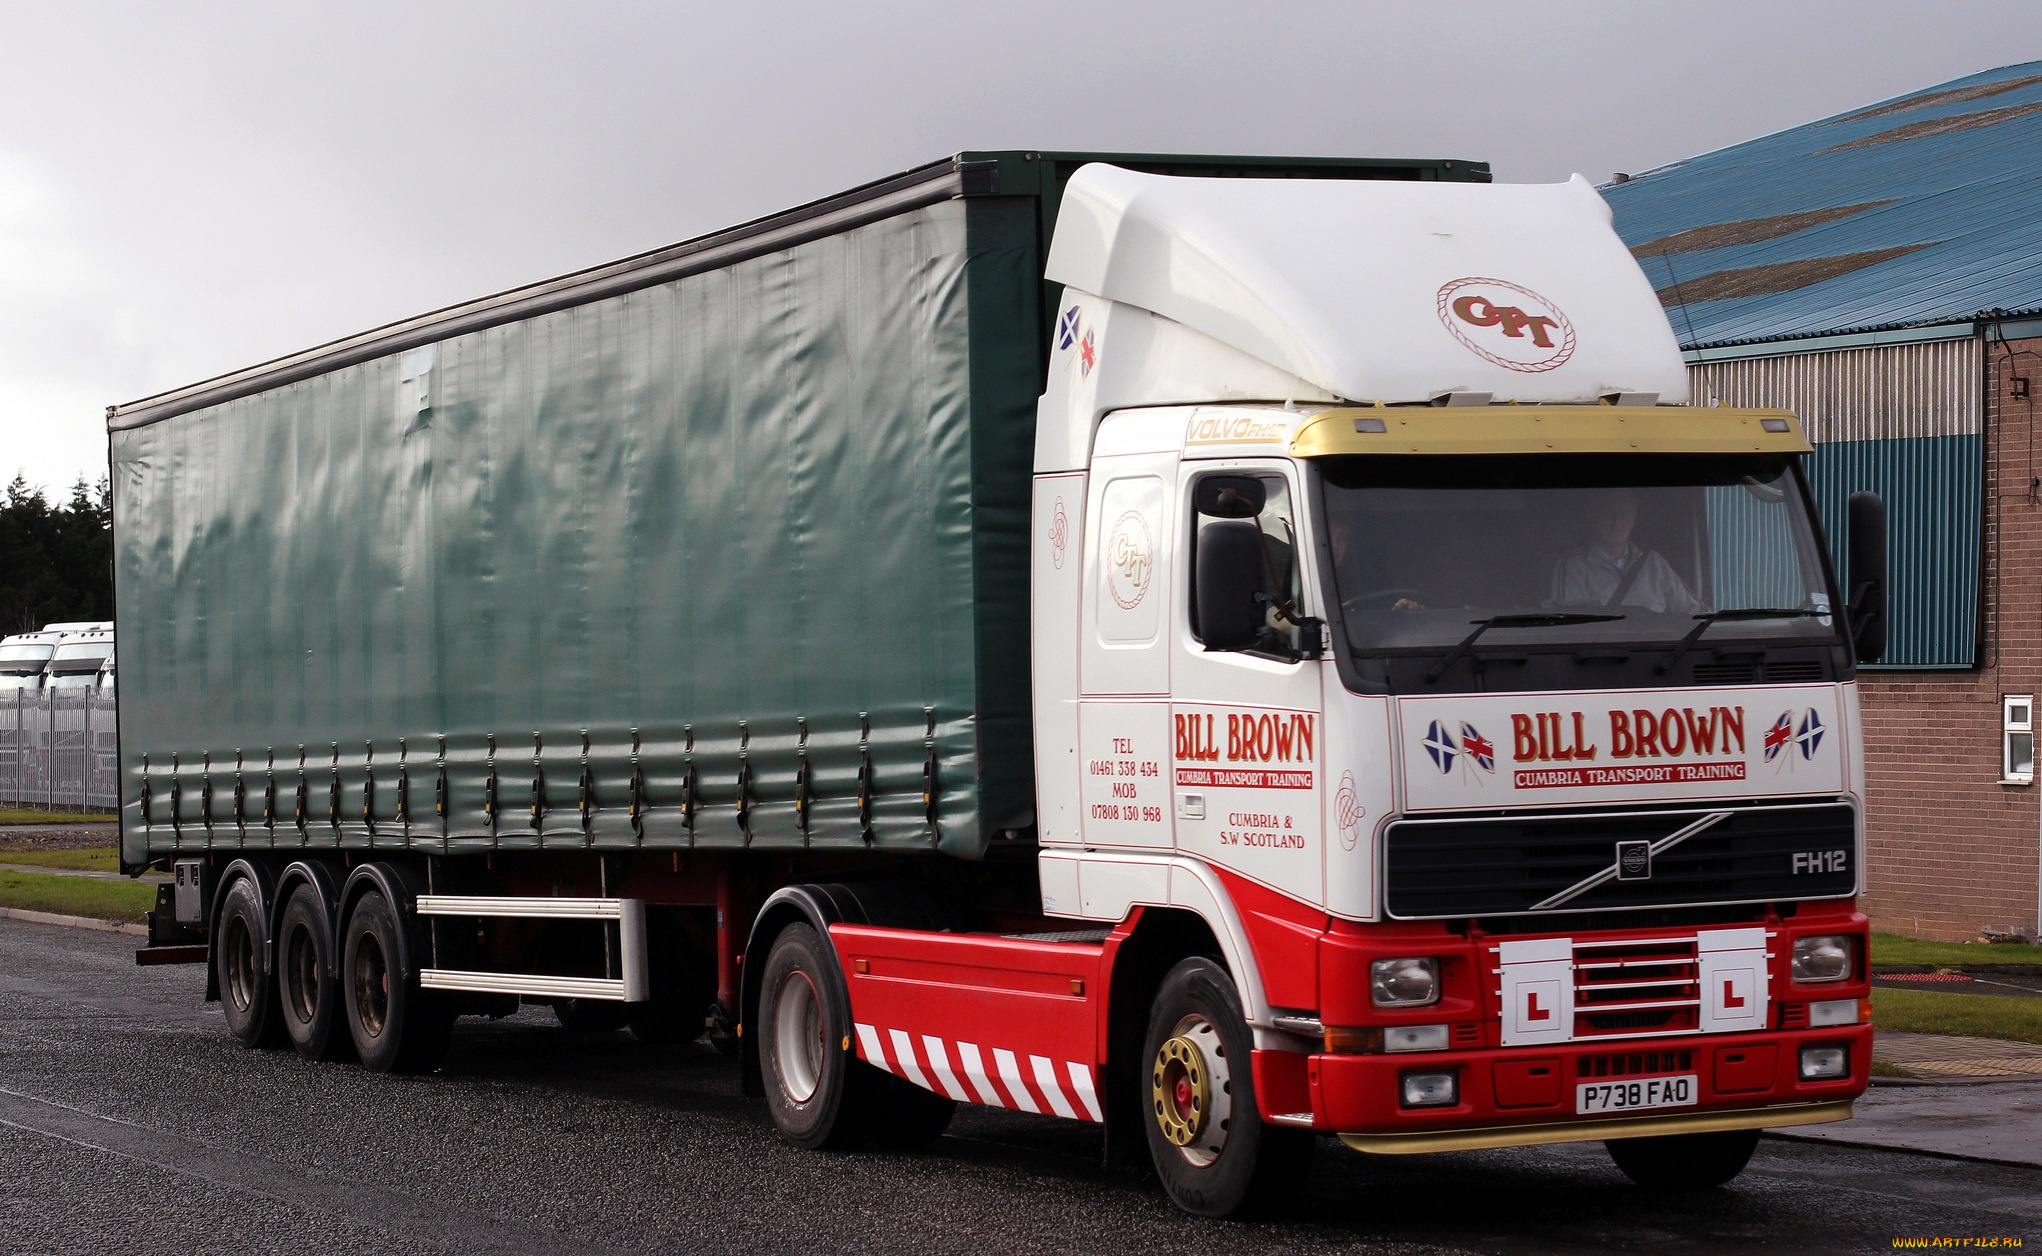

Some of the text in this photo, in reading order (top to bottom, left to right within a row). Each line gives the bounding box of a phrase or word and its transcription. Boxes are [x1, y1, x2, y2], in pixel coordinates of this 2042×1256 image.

[1187, 418, 1251, 440] VOLVO
[1175, 713, 1314, 763] BILL BROWN
[1511, 706, 1745, 763] BILL BROWN
[1112, 738, 1134, 754] TEL
[1090, 760, 1158, 777] 01461 338 434
[1176, 770, 1312, 787] CUMBRIA TRANSPORT TRAINING
[1515, 764, 1744, 787] CUMBRIA TRANSPORT TRAINING
[1112, 783, 1137, 799] MOB
[1092, 804, 1161, 822] 07808 130 968
[1229, 812, 1293, 829] CUMBRIA &
[1220, 831, 1305, 849] S.W SCOTLAND
[1792, 850, 1846, 875] FH12
[1723, 980, 1744, 1008] L
[1527, 992, 1549, 1021] L
[1585, 1079, 1688, 1110] P738 FAO
